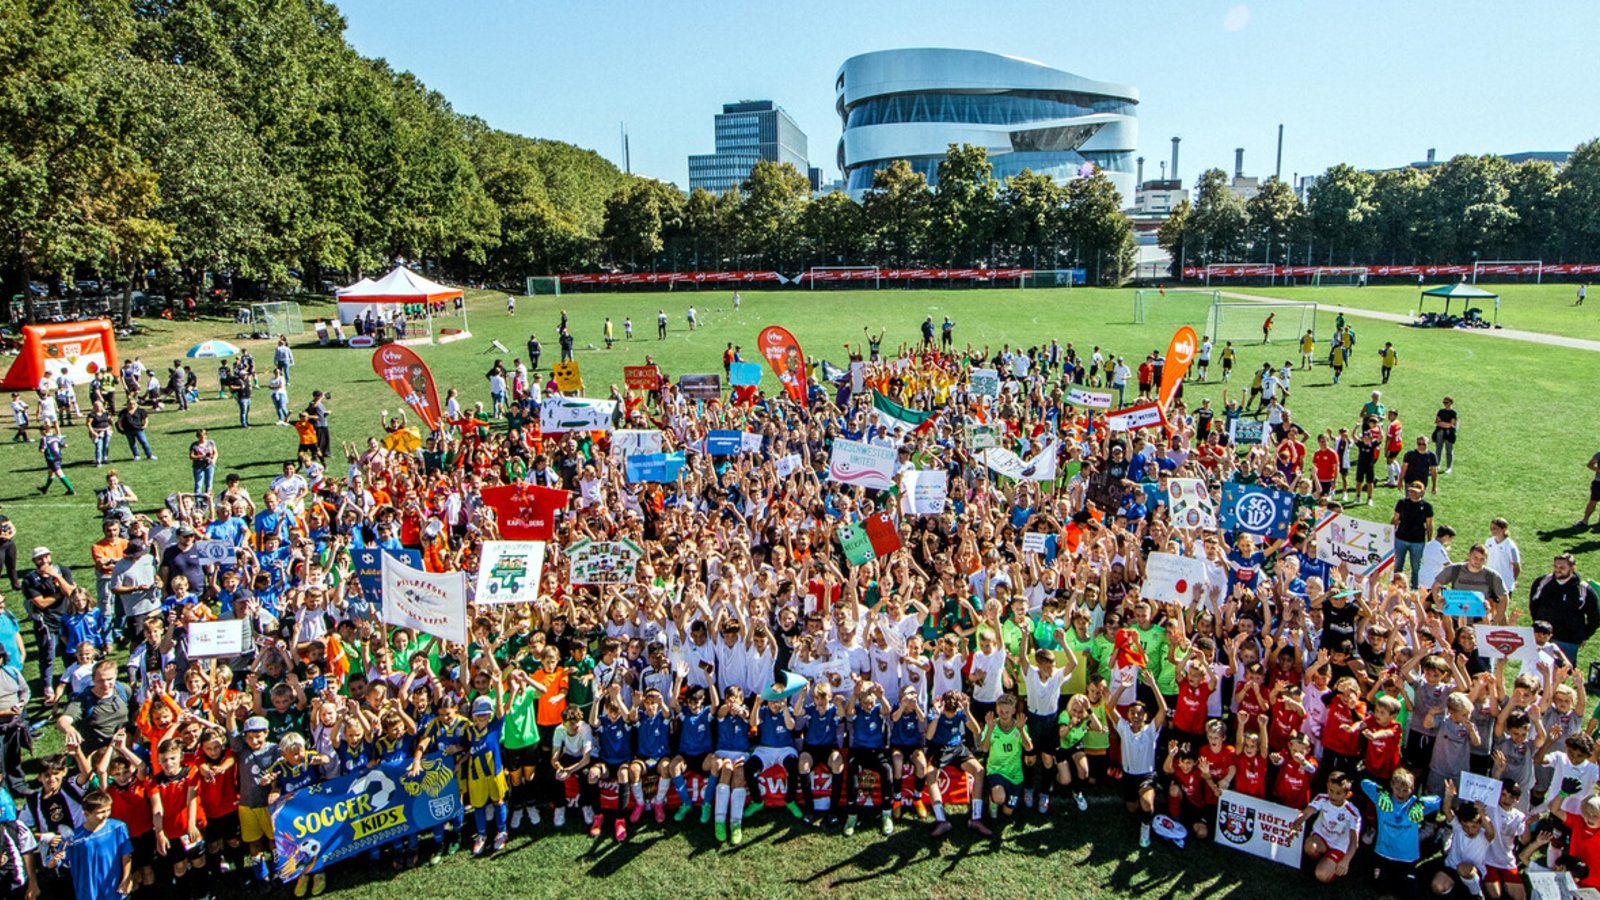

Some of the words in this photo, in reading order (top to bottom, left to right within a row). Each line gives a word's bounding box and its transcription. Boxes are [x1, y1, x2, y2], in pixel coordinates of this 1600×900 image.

[1174, 340, 1191, 355] wfv
[506, 519, 545, 527] KAPBERG
[1002, 743, 1013, 753] 10
[293, 793, 372, 839] SOCCER
[361, 808, 399, 835] KIDS
[1262, 833, 1292, 848] 2023
